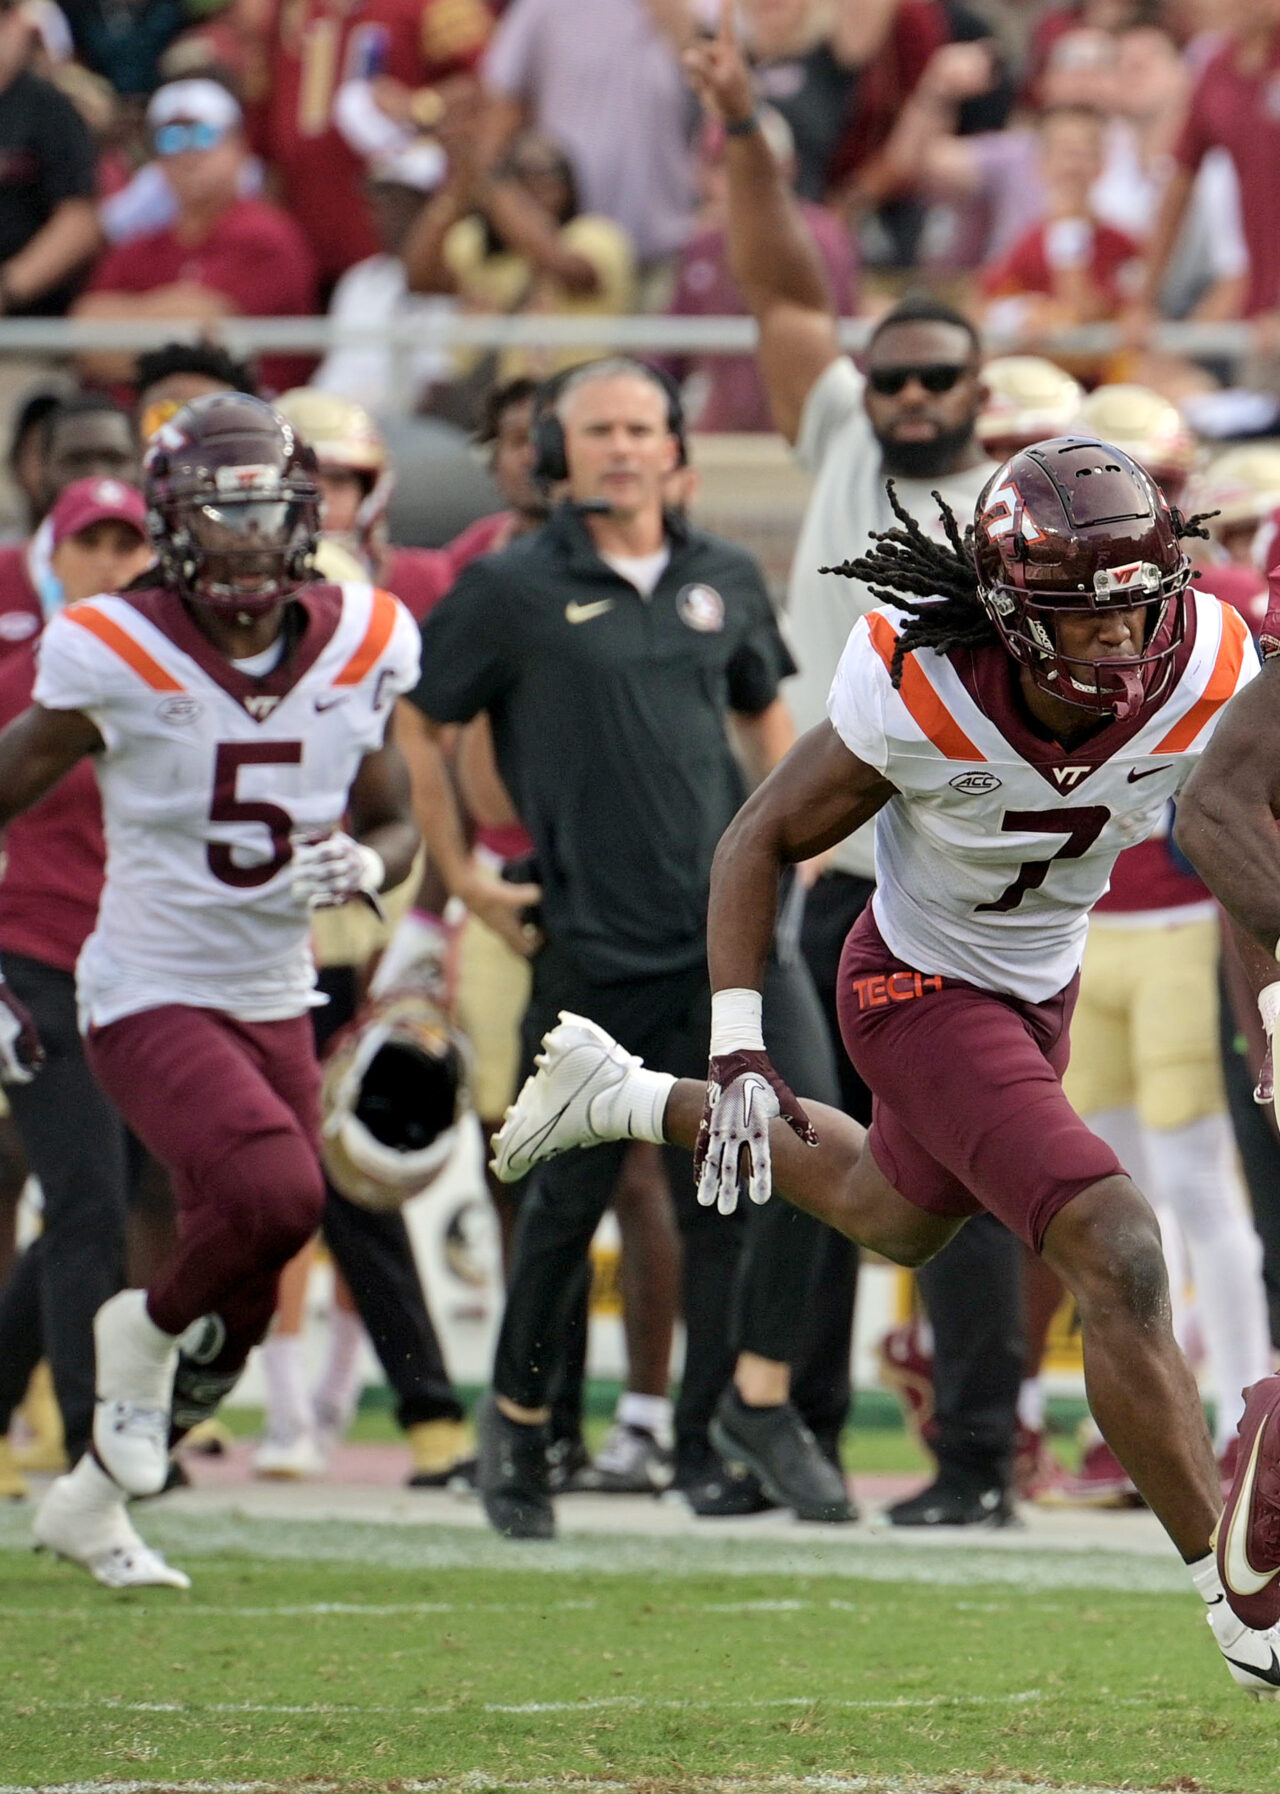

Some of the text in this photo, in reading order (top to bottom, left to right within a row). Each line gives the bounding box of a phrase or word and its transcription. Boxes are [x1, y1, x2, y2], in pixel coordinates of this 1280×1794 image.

[1112, 565, 1141, 585] VT
[964, 776, 996, 788] ACC
[1052, 766, 1092, 785] VT
[206, 741, 304, 888] 5
[973, 804, 1112, 913] 7
[852, 971, 943, 1011] TECH
